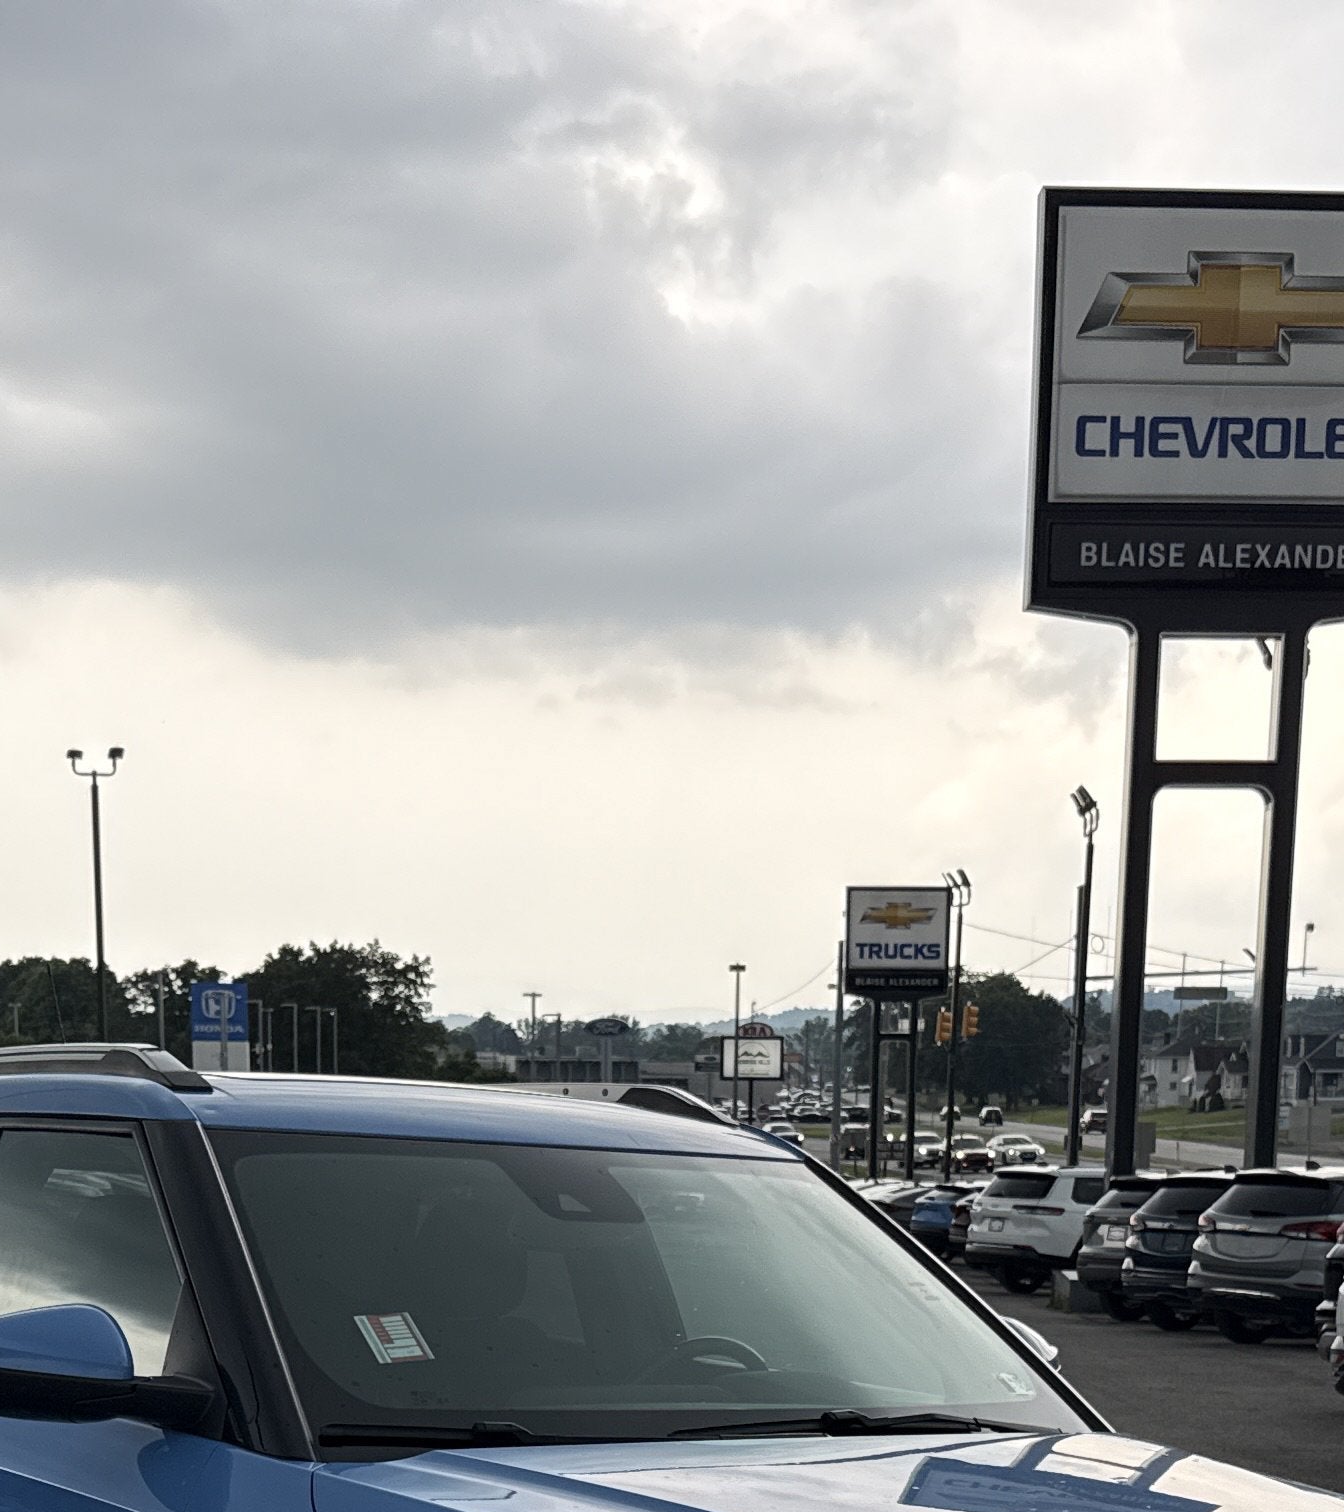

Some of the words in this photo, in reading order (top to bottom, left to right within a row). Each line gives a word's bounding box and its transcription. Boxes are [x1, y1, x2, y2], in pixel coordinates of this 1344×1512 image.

[1079, 542, 1186, 569] BLAISE
[855, 942, 941, 960] TRUCKS
[855, 977, 886, 986] BLAISE
[889, 977, 940, 987] ALEXANDER
